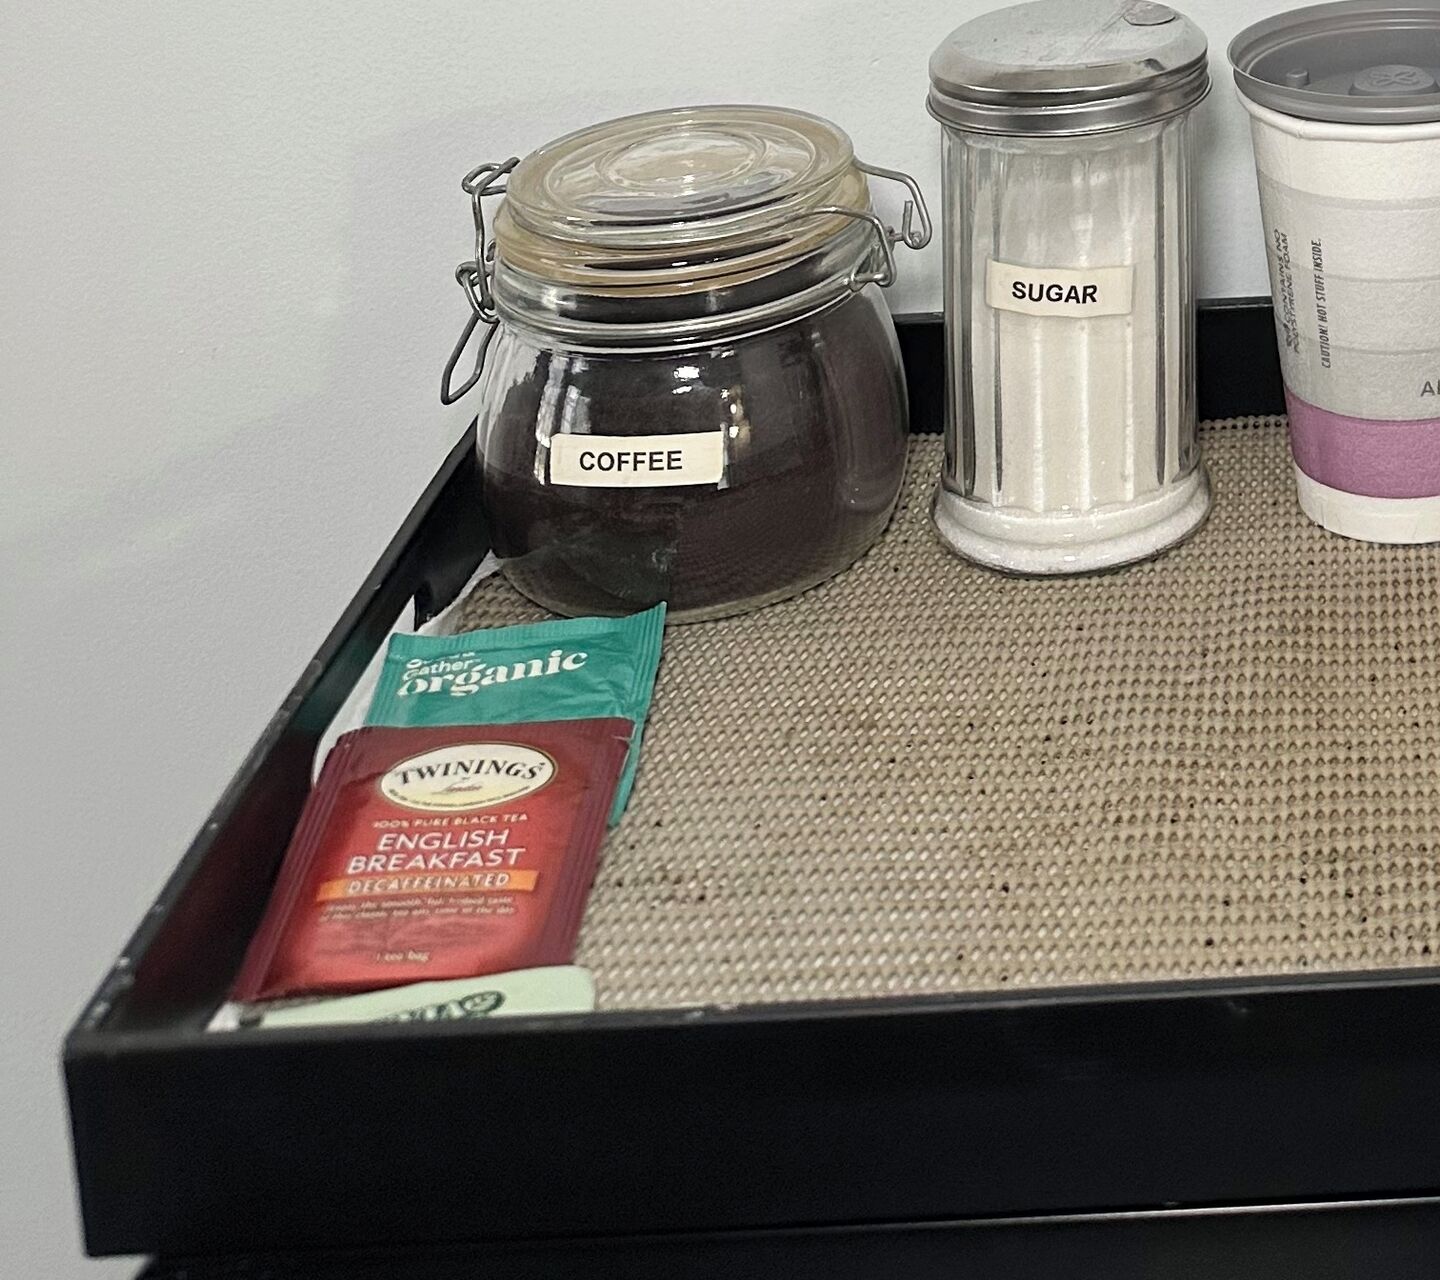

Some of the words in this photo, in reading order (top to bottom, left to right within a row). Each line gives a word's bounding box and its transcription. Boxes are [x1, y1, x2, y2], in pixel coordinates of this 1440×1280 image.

[1011, 281, 1098, 305] SUGAR
[1314, 274, 1326, 302] STUFF
[1316, 304, 1328, 323] HOT
[1319, 324, 1332, 369] CAUTION!
[578, 449, 683, 472] COFFEE
[397, 649, 588, 697] organic
[396, 759, 543, 785] TWININGS
[372, 819, 410, 829] 100%
[413, 817, 449, 827] PURE
[454, 815, 499, 826] BLACK
[503, 813, 528, 822] TEA
[377, 828, 510, 852] ENGLISH
[347, 847, 526, 874] BREAKFAST
[347, 872, 510, 894] DECAFFEINATED
